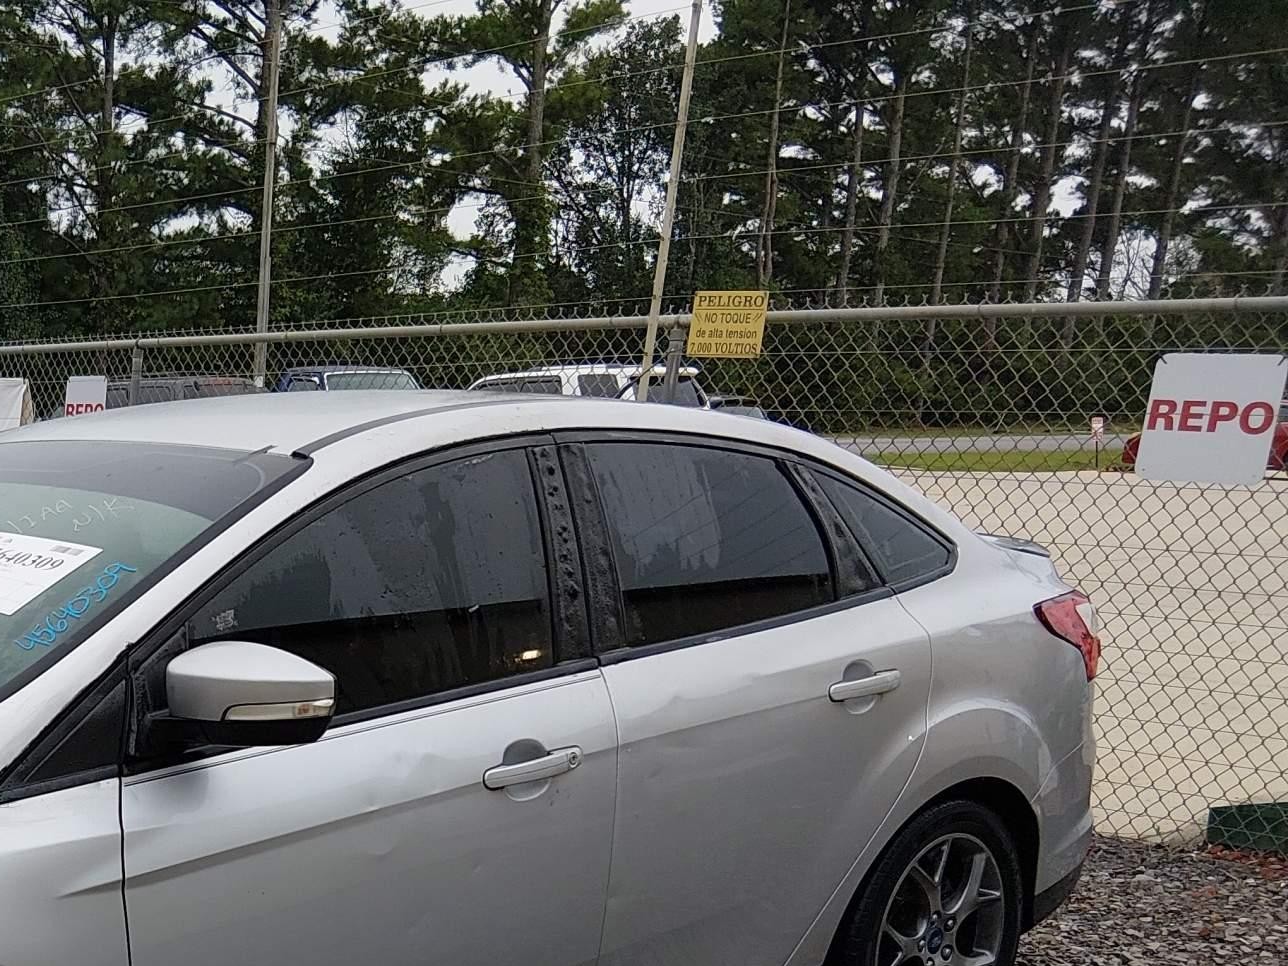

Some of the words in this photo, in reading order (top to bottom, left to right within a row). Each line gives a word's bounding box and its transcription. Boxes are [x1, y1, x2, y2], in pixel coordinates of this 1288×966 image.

[698, 295, 764, 307] PELIGRO
[704, 312, 718, 324] NO
[721, 312, 751, 324] TOQUE
[695, 327, 706, 338] de
[708, 327, 723, 339] alta
[714, 342, 757, 354] VOLTIOS
[1146, 399, 1275, 435] REPO
[14, 561, 137, 651] 45640309
